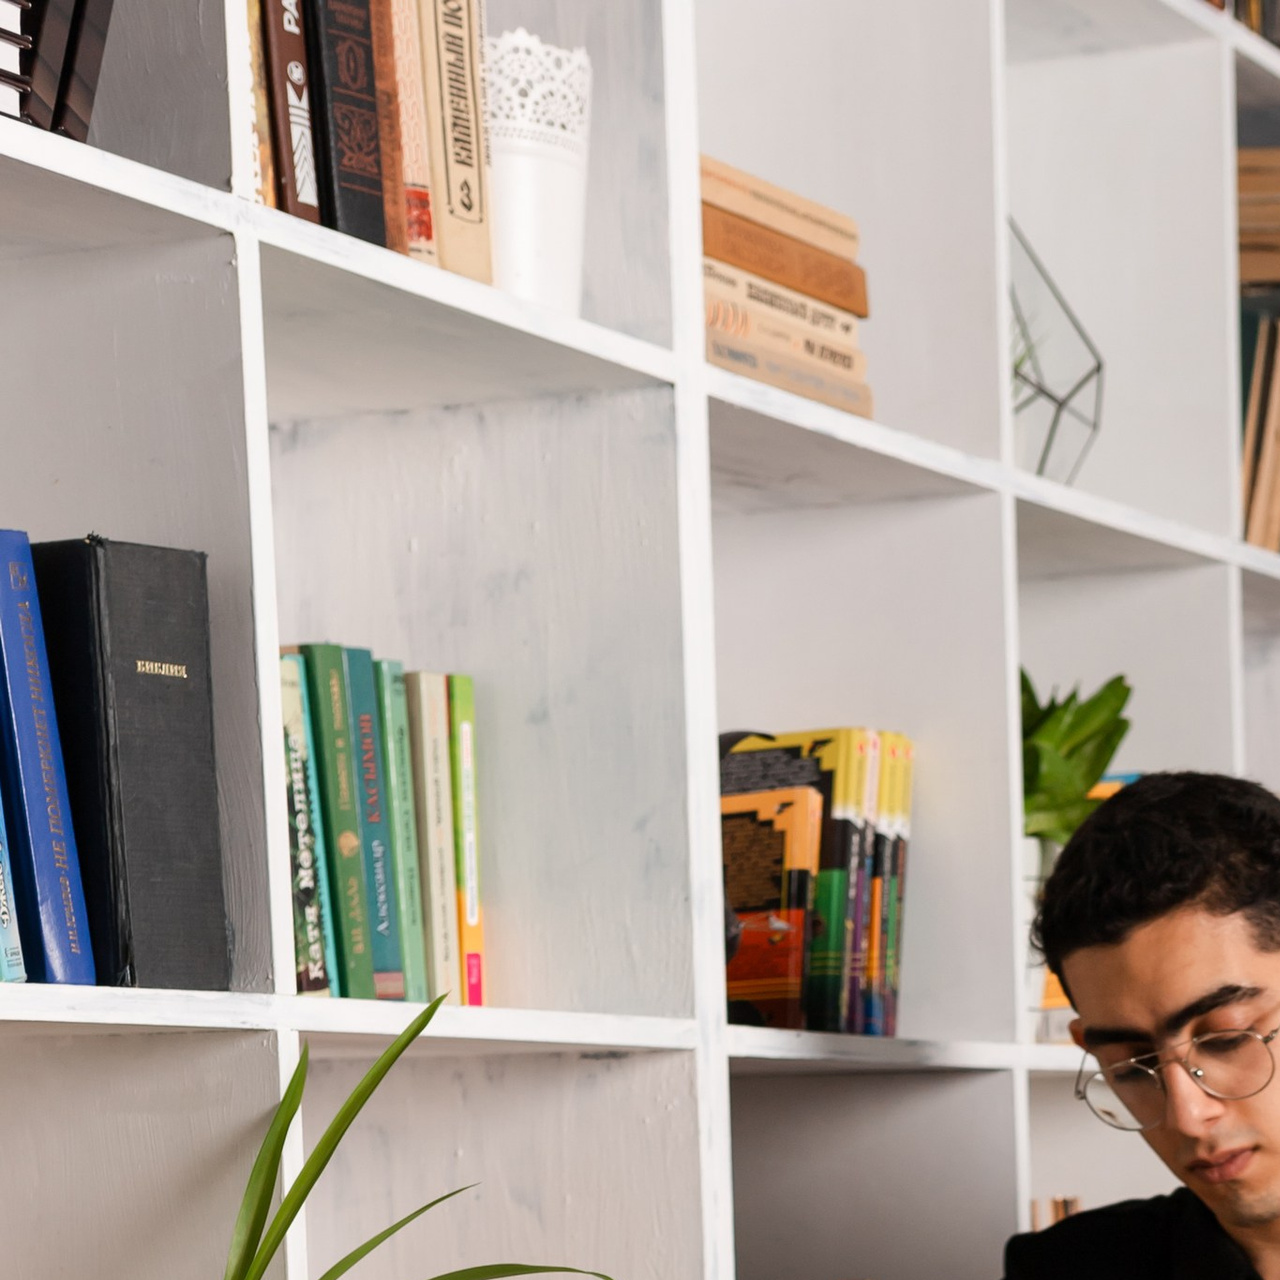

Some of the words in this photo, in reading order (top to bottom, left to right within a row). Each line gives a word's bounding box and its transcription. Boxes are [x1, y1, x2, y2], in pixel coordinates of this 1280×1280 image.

[136, 659, 188, 679] БИБЛИЯ
[288, 733, 316, 891] Метелица
[358, 713, 382, 824] КАСЫМОВ
[304, 904, 326, 981] Катя
